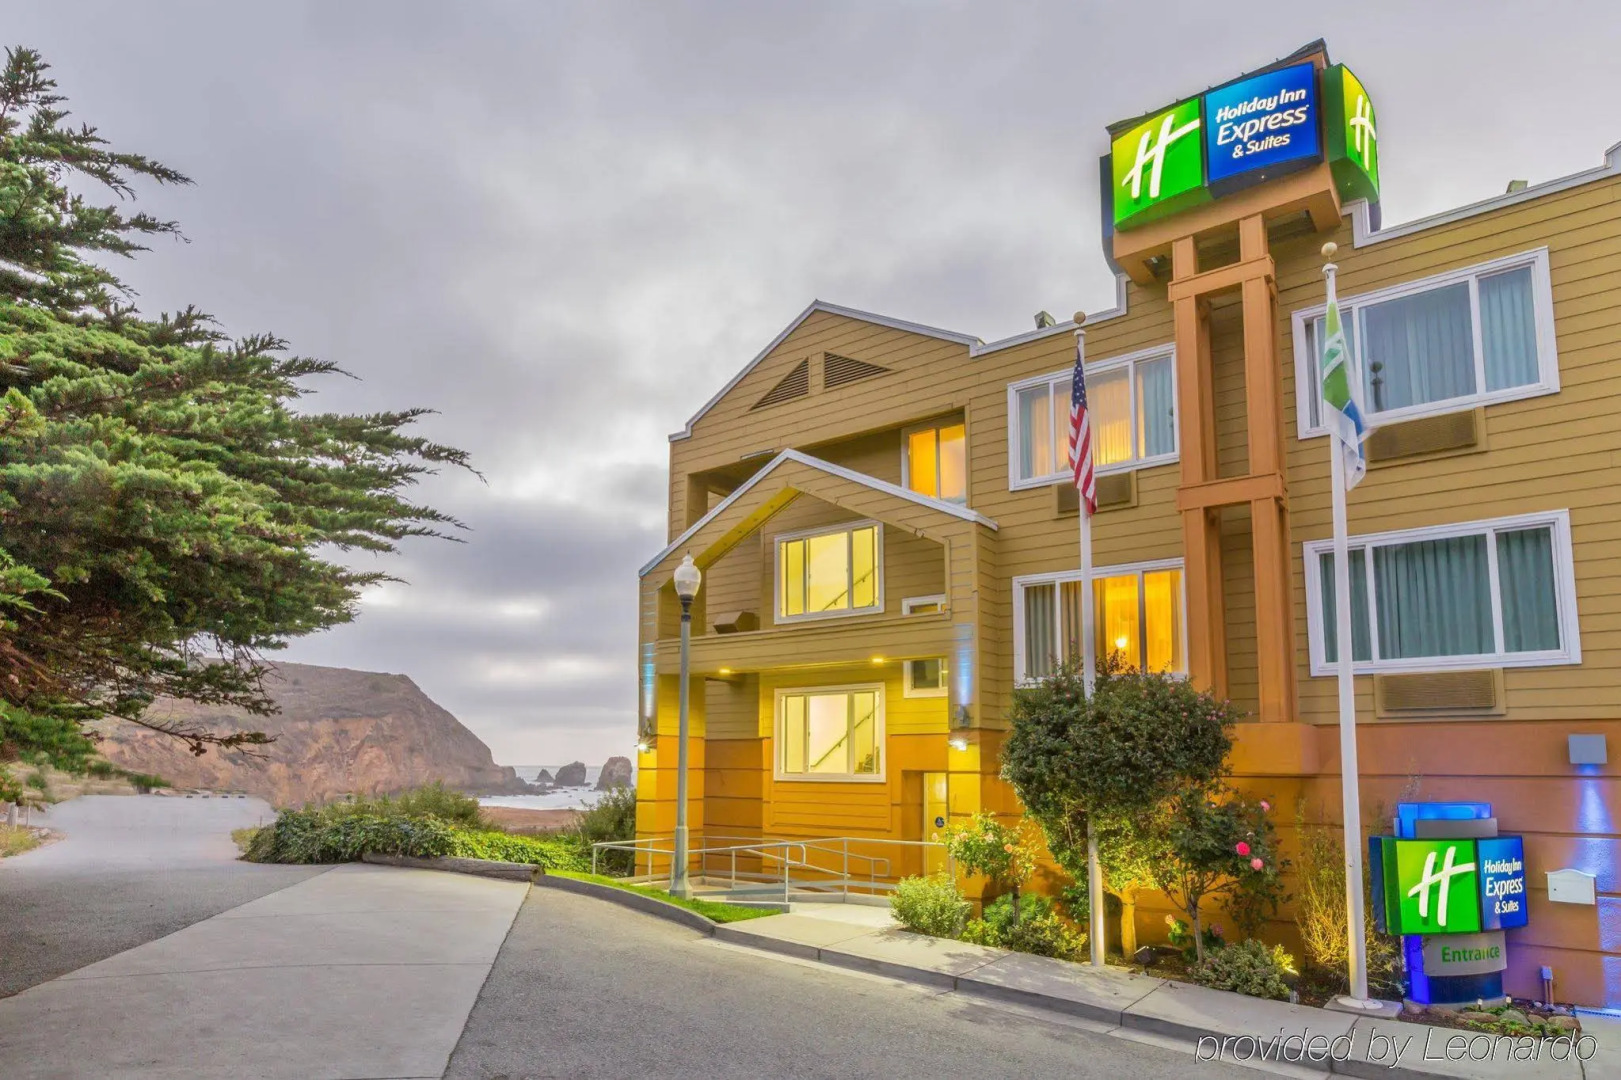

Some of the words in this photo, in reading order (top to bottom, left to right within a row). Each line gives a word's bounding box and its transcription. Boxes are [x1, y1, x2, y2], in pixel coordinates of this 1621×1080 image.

[1215, 96, 1279, 123] Holiday
[1279, 88, 1306, 104] Inn
[1216, 106, 1308, 146] Express
[1232, 144, 1244, 158] &
[1245, 133, 1291, 155] Suites
[1484, 858, 1513, 876] Holiday
[1512, 857, 1522, 871] Inn
[1485, 876, 1523, 900] Express
[1494, 901, 1501, 914] &
[1501, 900, 1519, 913] Suites
[1441, 944, 1500, 963] Entrance
